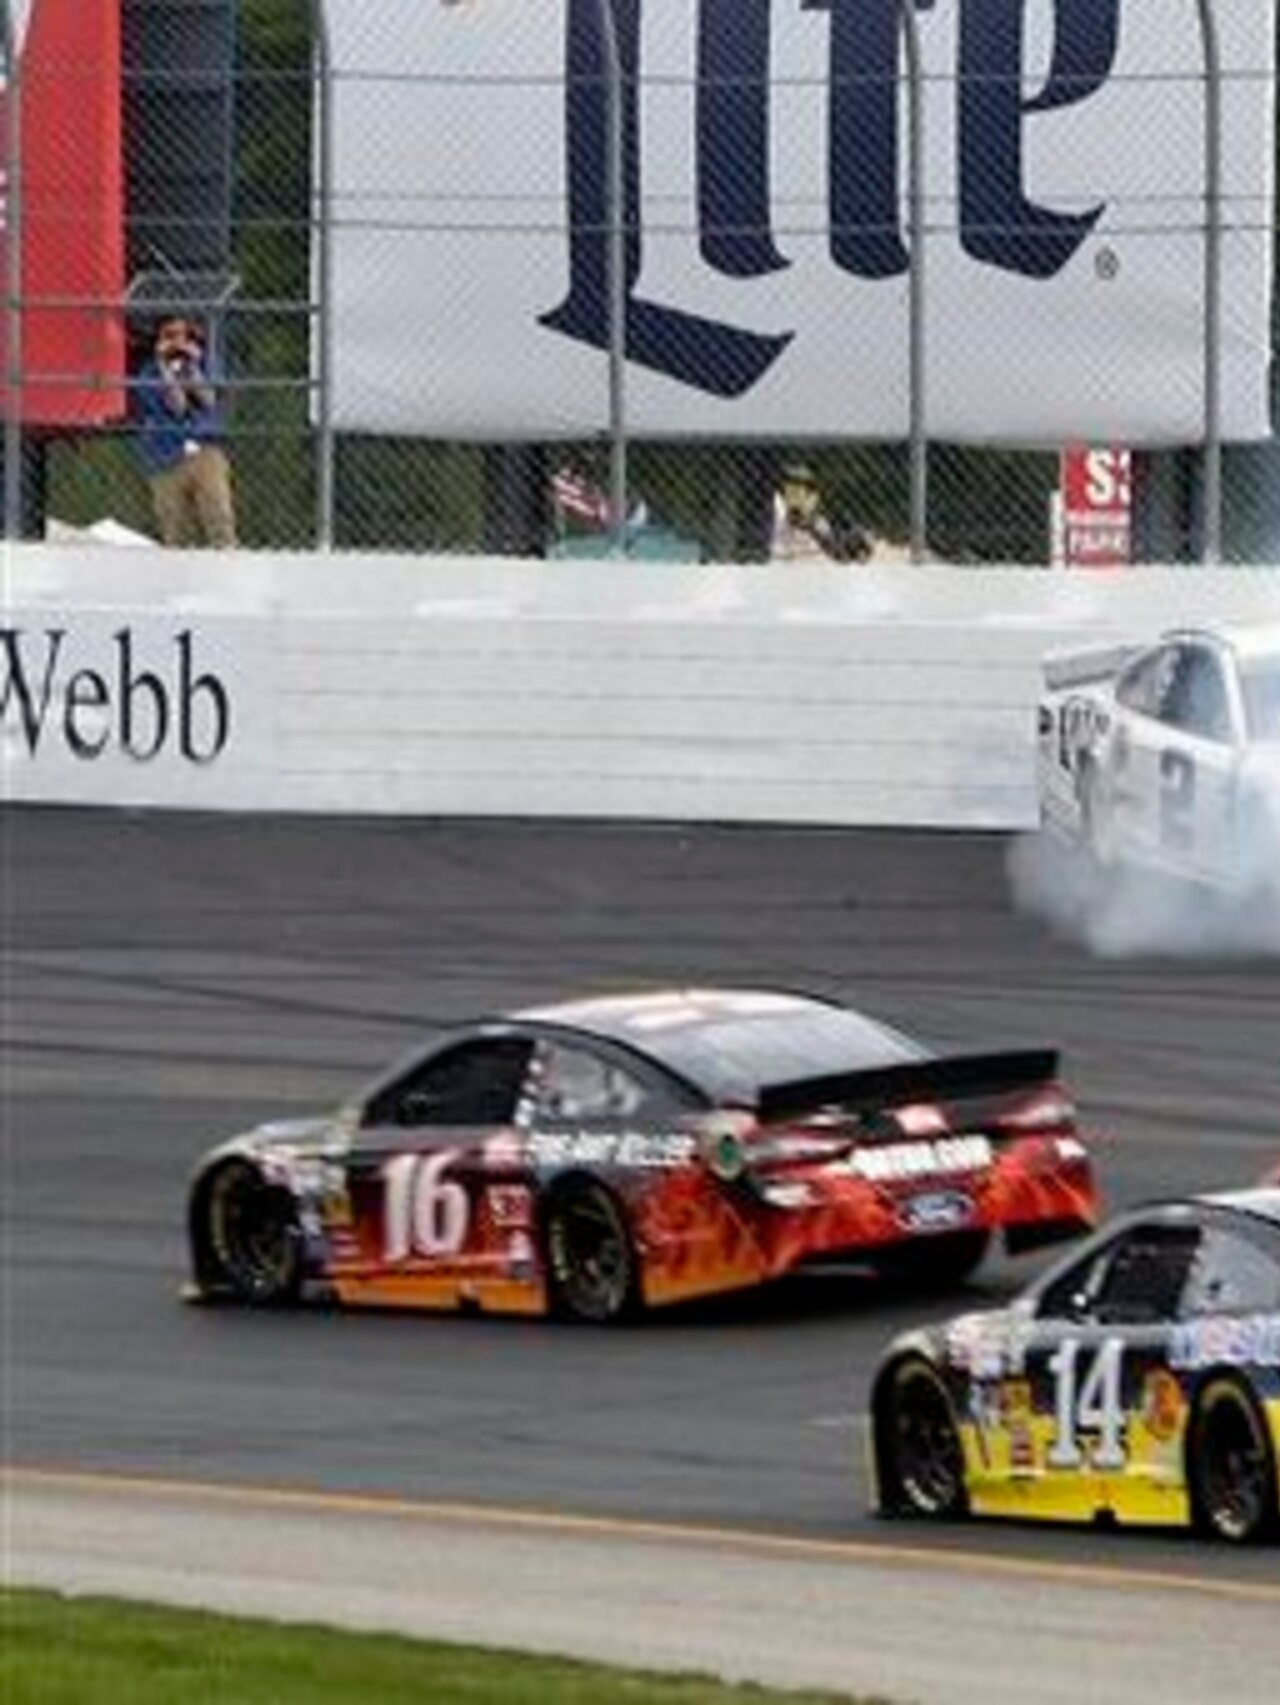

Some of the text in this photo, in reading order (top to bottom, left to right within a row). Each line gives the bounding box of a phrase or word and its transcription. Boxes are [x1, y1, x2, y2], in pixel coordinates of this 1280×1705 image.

[0, 625, 229, 766] Webb
[381, 1150, 468, 1263] 16
[1047, 1337, 1127, 1468] 14
